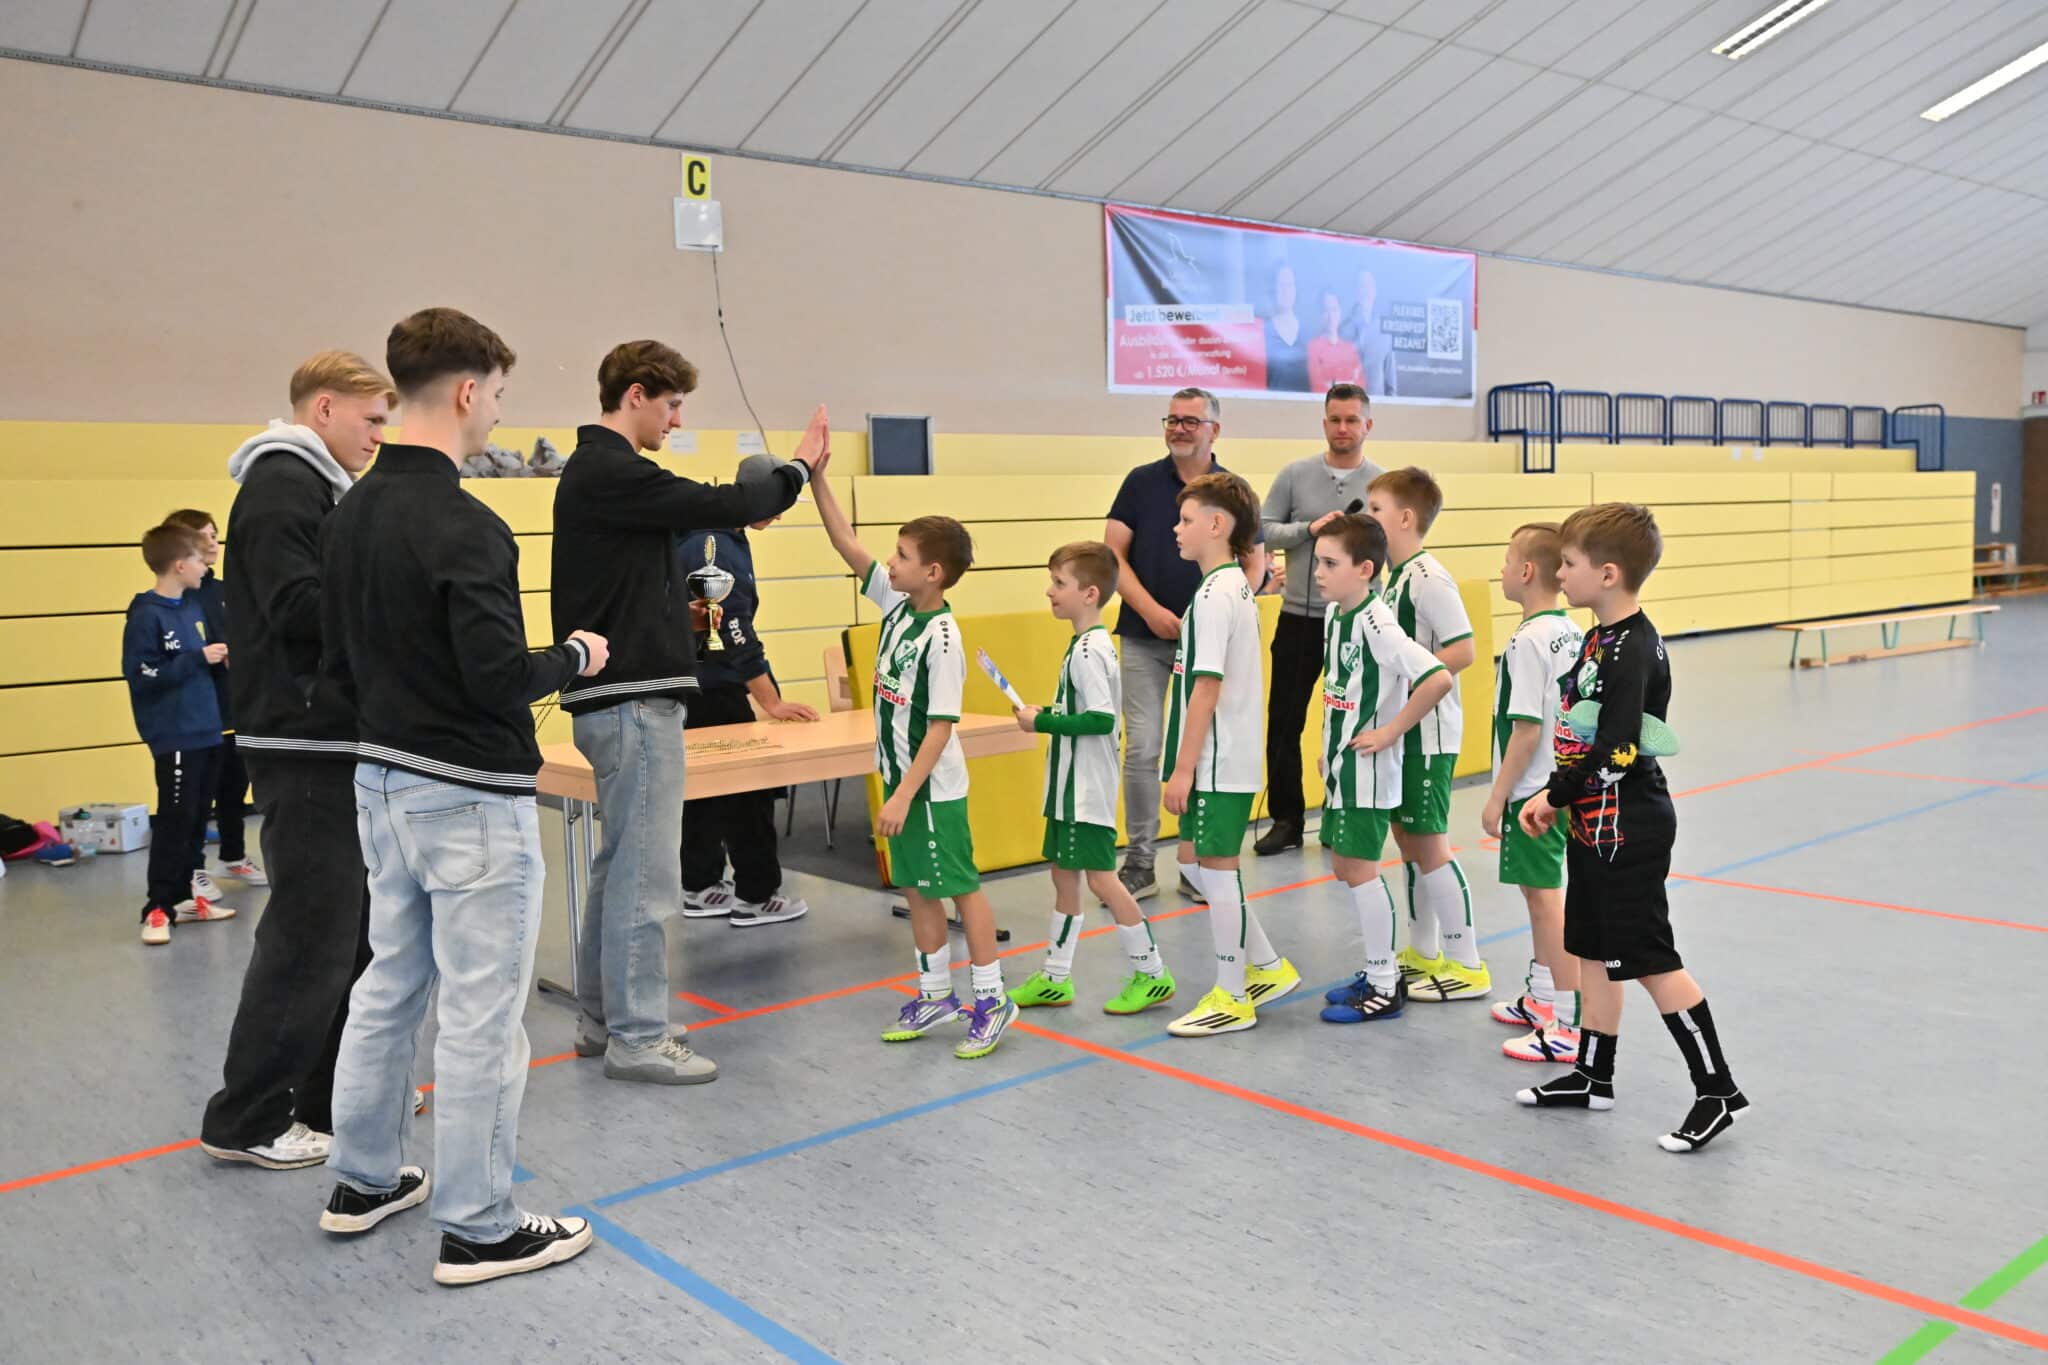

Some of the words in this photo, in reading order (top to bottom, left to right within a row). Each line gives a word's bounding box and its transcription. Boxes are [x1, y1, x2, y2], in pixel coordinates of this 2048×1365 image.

[688, 160, 706, 196] C
[1147, 364, 1175, 379] 1.520
[164, 640, 181, 651] NC
